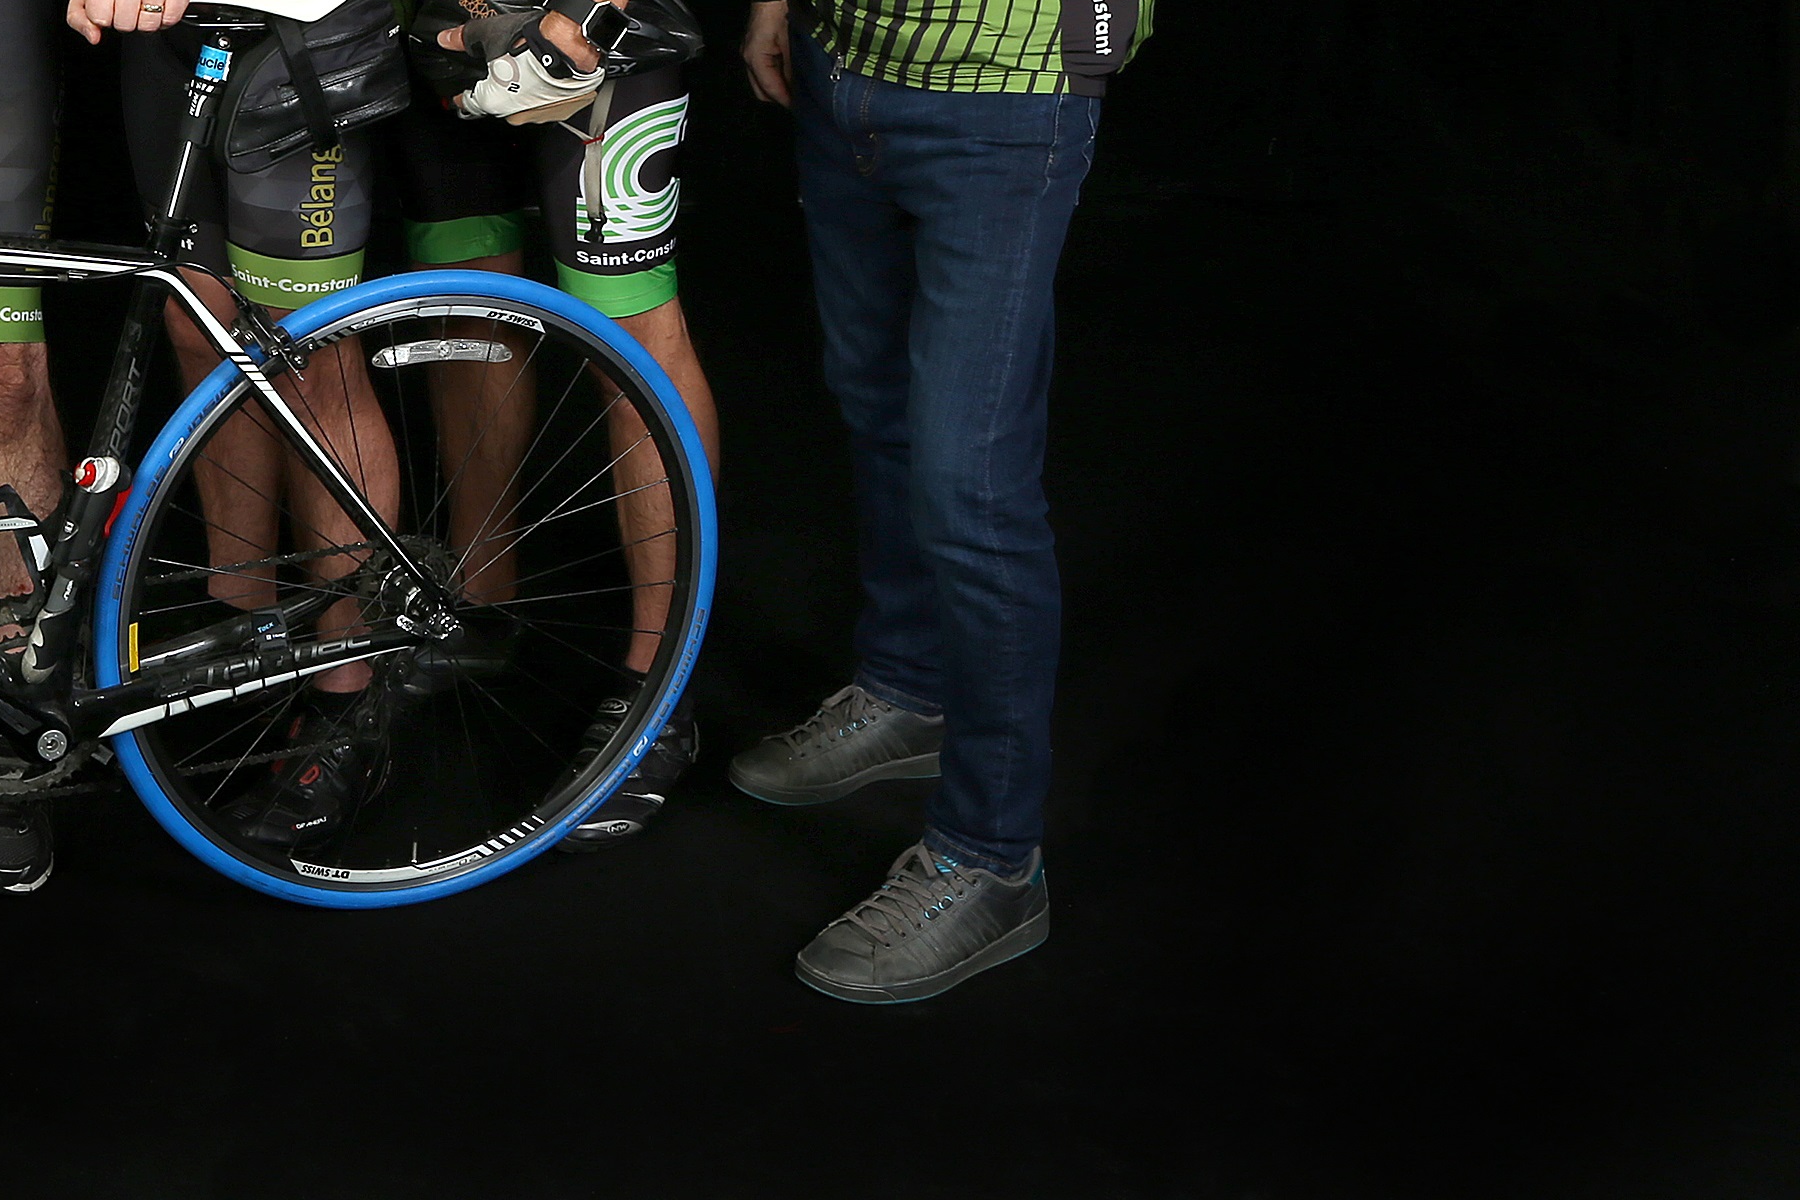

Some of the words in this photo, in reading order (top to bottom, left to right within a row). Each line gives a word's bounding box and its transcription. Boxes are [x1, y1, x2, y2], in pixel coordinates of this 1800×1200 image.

[486, 310, 505, 321] DT
[505, 312, 539, 328] SWISS
[109, 356, 142, 459] PORT
[301, 864, 330, 878] SWISS
